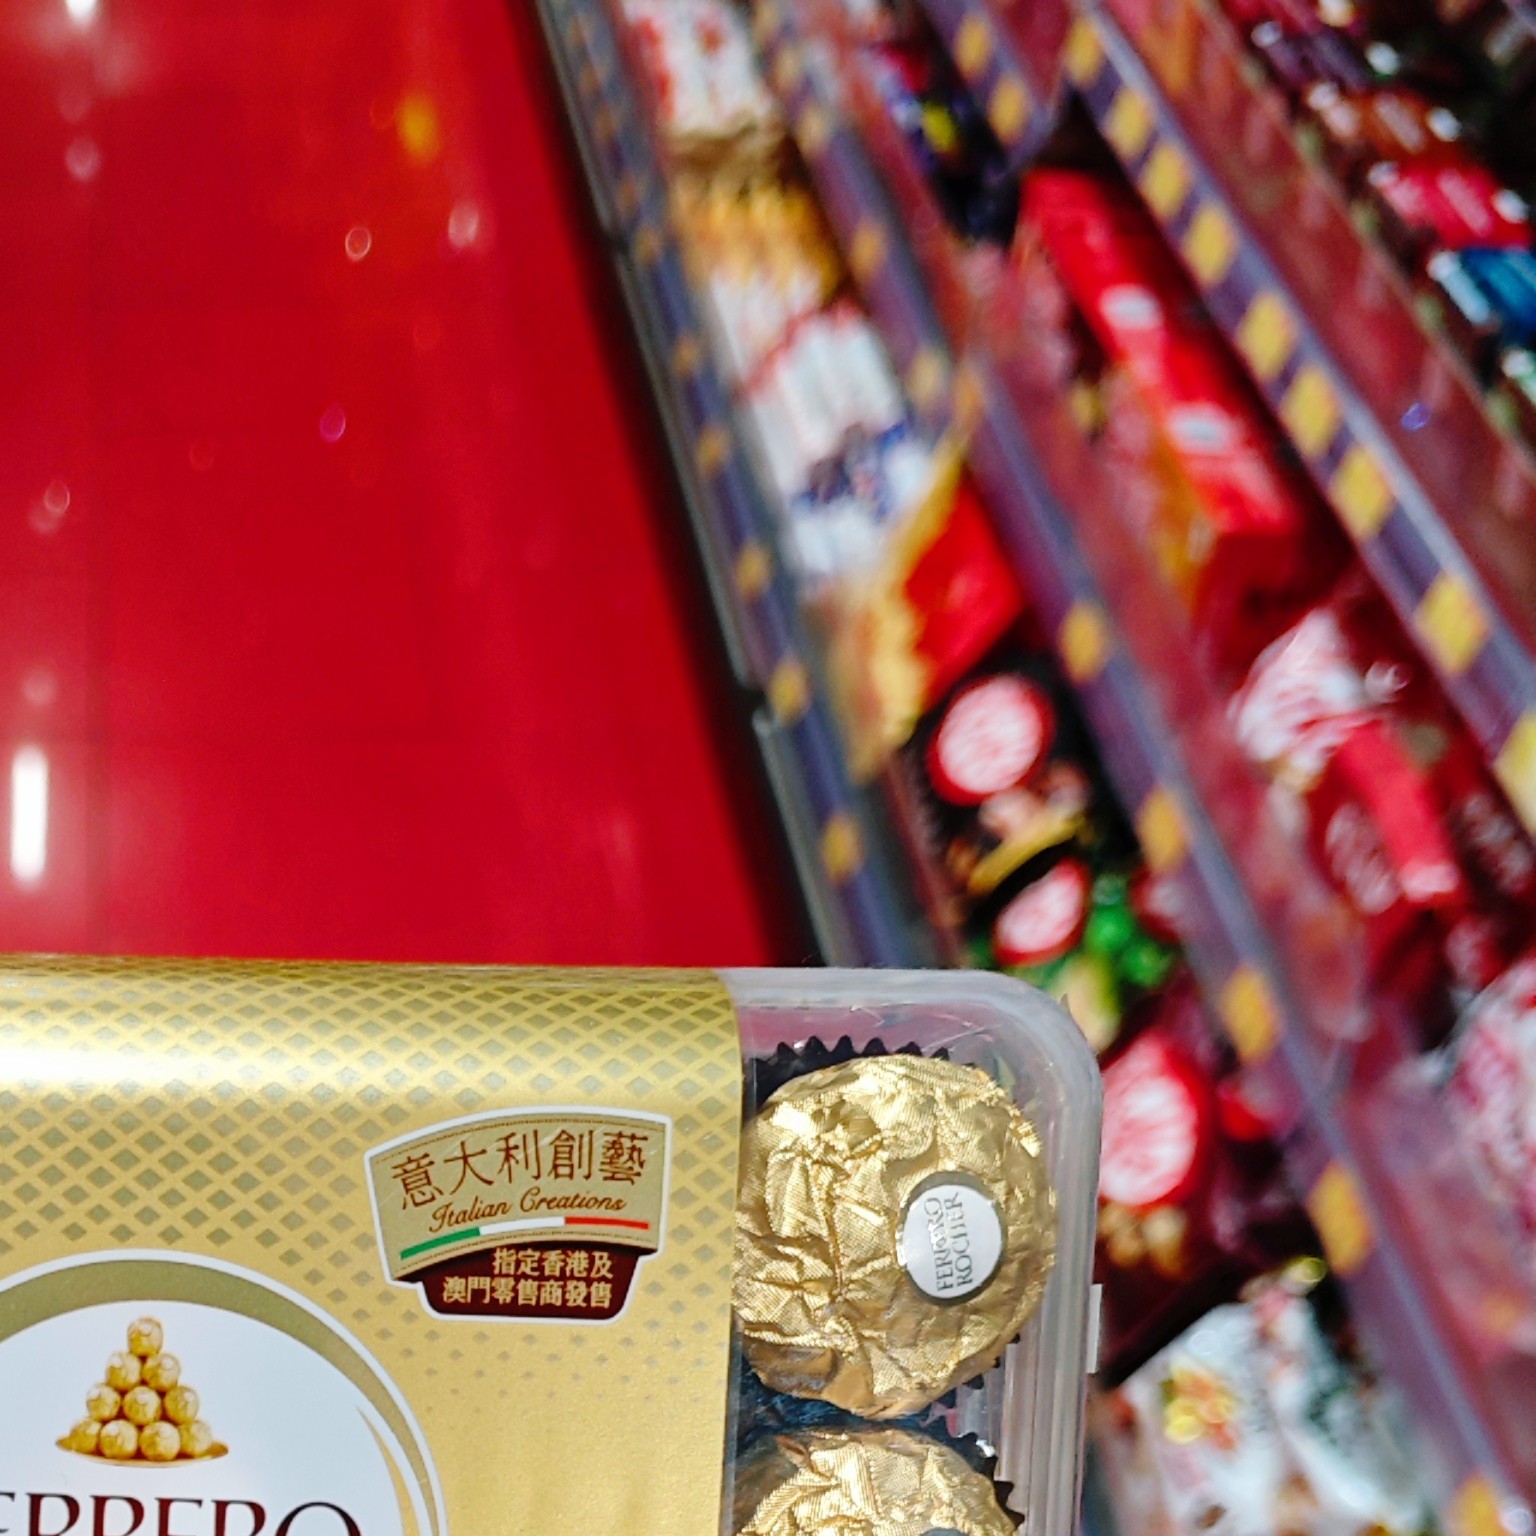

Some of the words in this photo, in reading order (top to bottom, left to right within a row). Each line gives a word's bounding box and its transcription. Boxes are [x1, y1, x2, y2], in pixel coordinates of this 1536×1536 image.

[390, 1128, 650, 1212] 意大利創藝
[428, 1195, 512, 1233] Italian
[519, 1186, 628, 1213] Creations
[492, 1247, 614, 1279] 指定香港及
[442, 1276, 613, 1309] 澳門零售商發售
